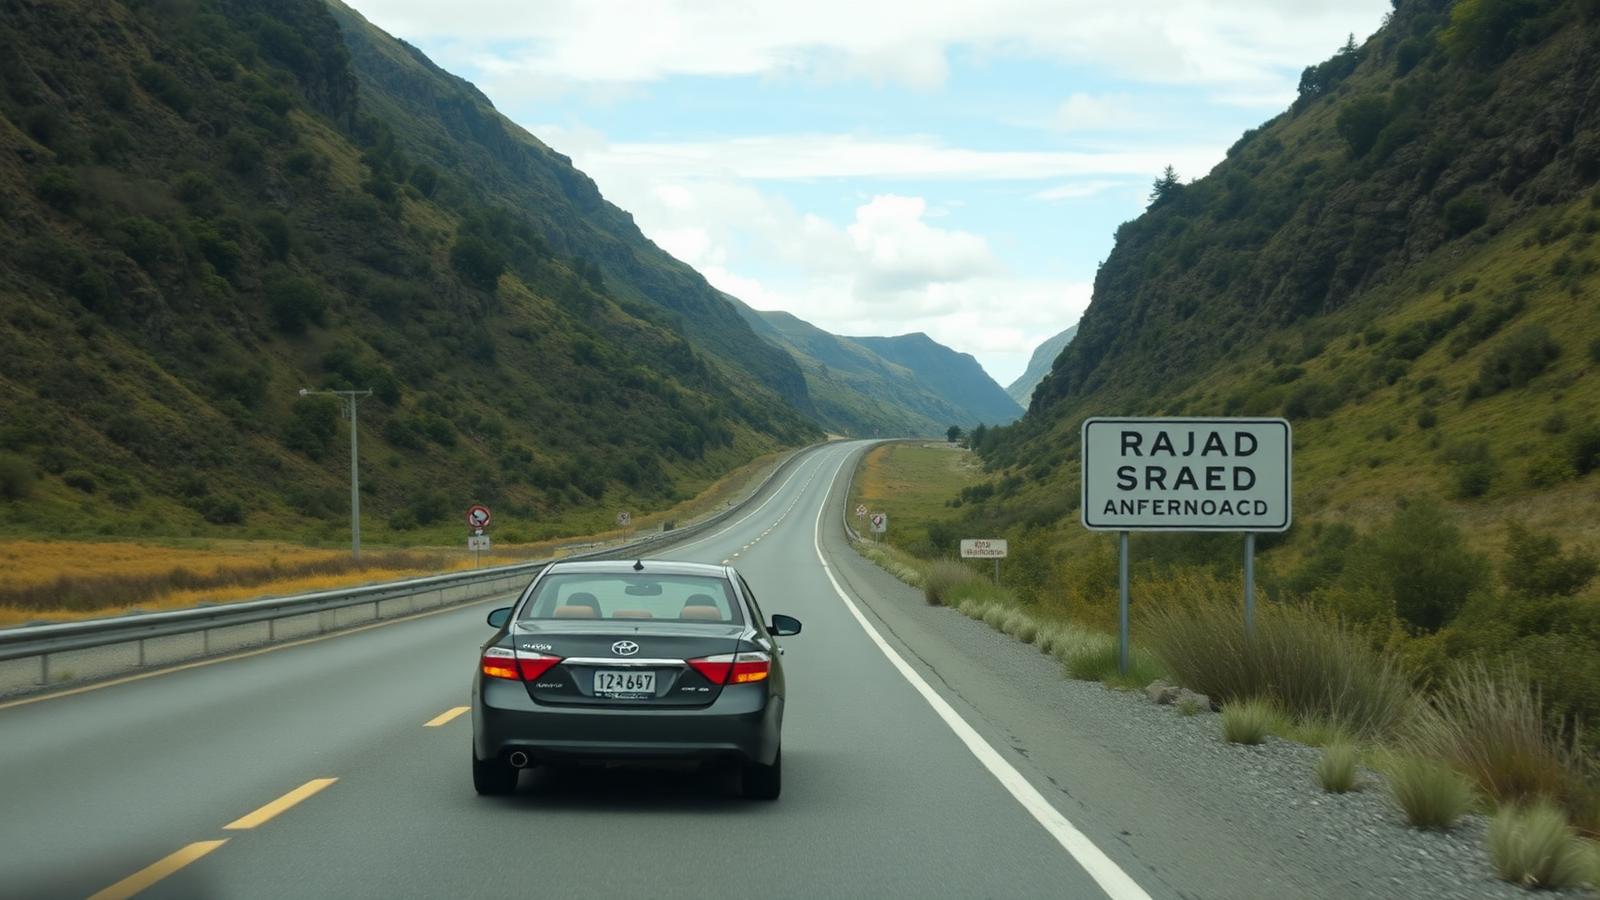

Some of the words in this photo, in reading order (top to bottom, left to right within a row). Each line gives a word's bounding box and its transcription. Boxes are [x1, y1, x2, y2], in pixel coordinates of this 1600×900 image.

[1120, 431, 1259, 457] RAJAD
[1116, 465, 1257, 491] SRAED
[1103, 499, 1269, 516] ANFERNOACD
